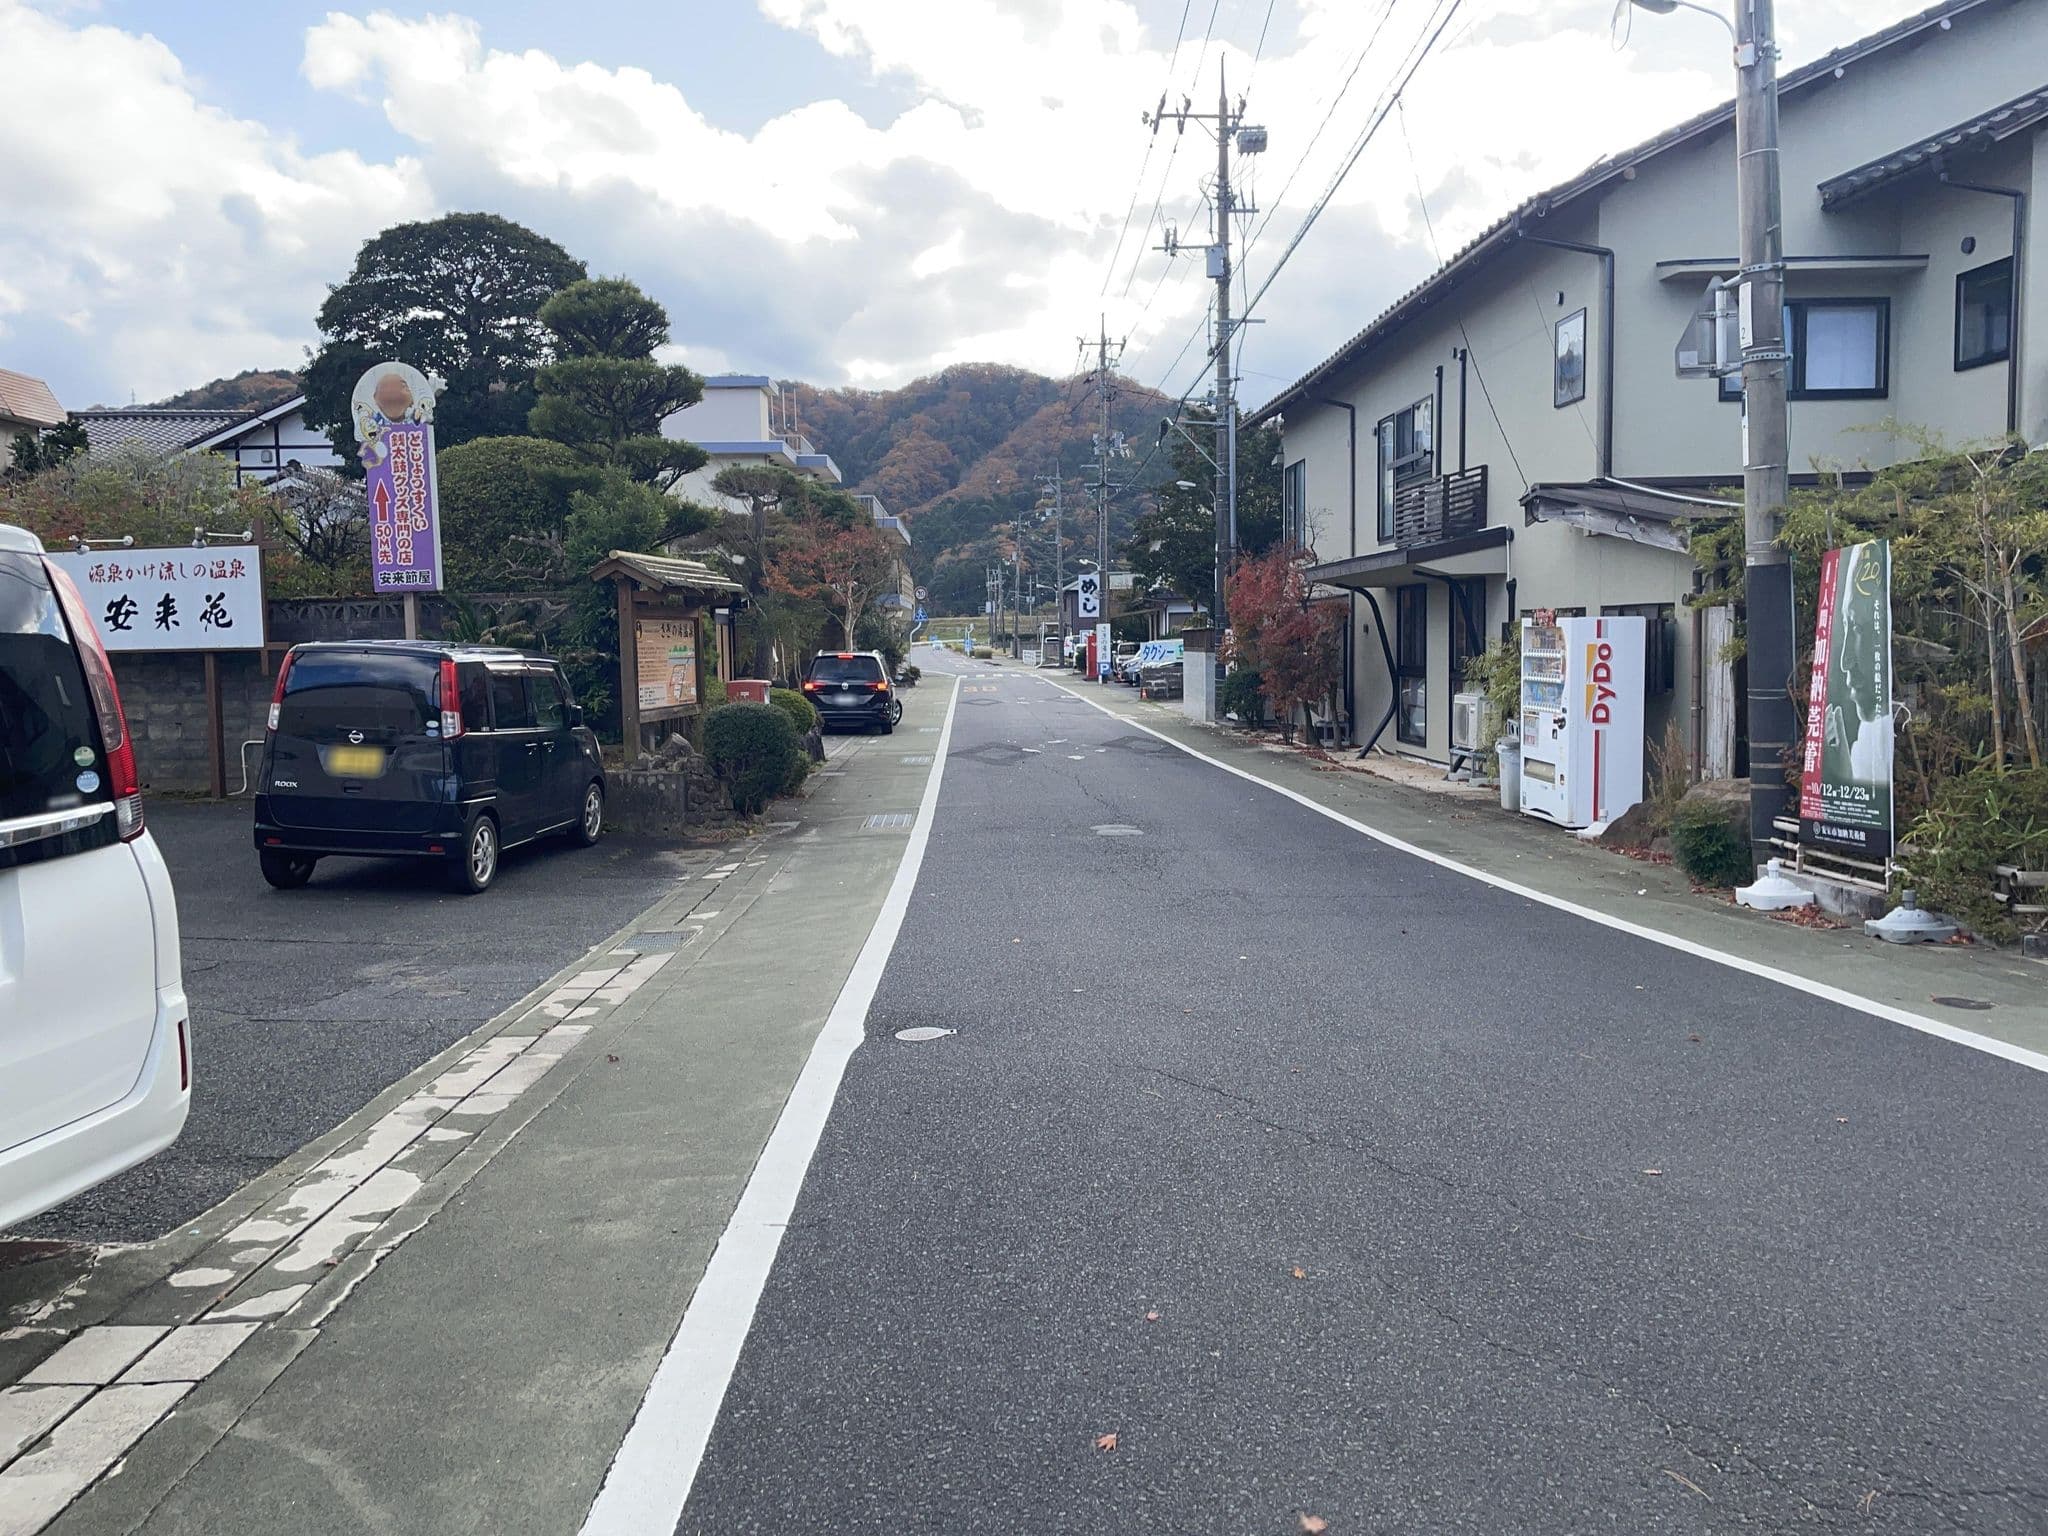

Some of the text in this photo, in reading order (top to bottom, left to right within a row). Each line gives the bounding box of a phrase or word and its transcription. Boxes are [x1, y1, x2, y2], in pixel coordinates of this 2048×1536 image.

[391, 433, 413, 565] 銭太鼓グッズ専門の店
[409, 432, 428, 532] どじょうすくい
[88, 558, 246, 583] 源泉かけ流しの温泉
[379, 571, 432, 586] 安来節屋
[104, 592, 233, 632] 安来苑
[1081, 579, 1098, 613] めし
[1142, 644, 1175, 661] タクシー
[1100, 665, 1109, 675] P
[1592, 643, 1616, 724] DyDo
